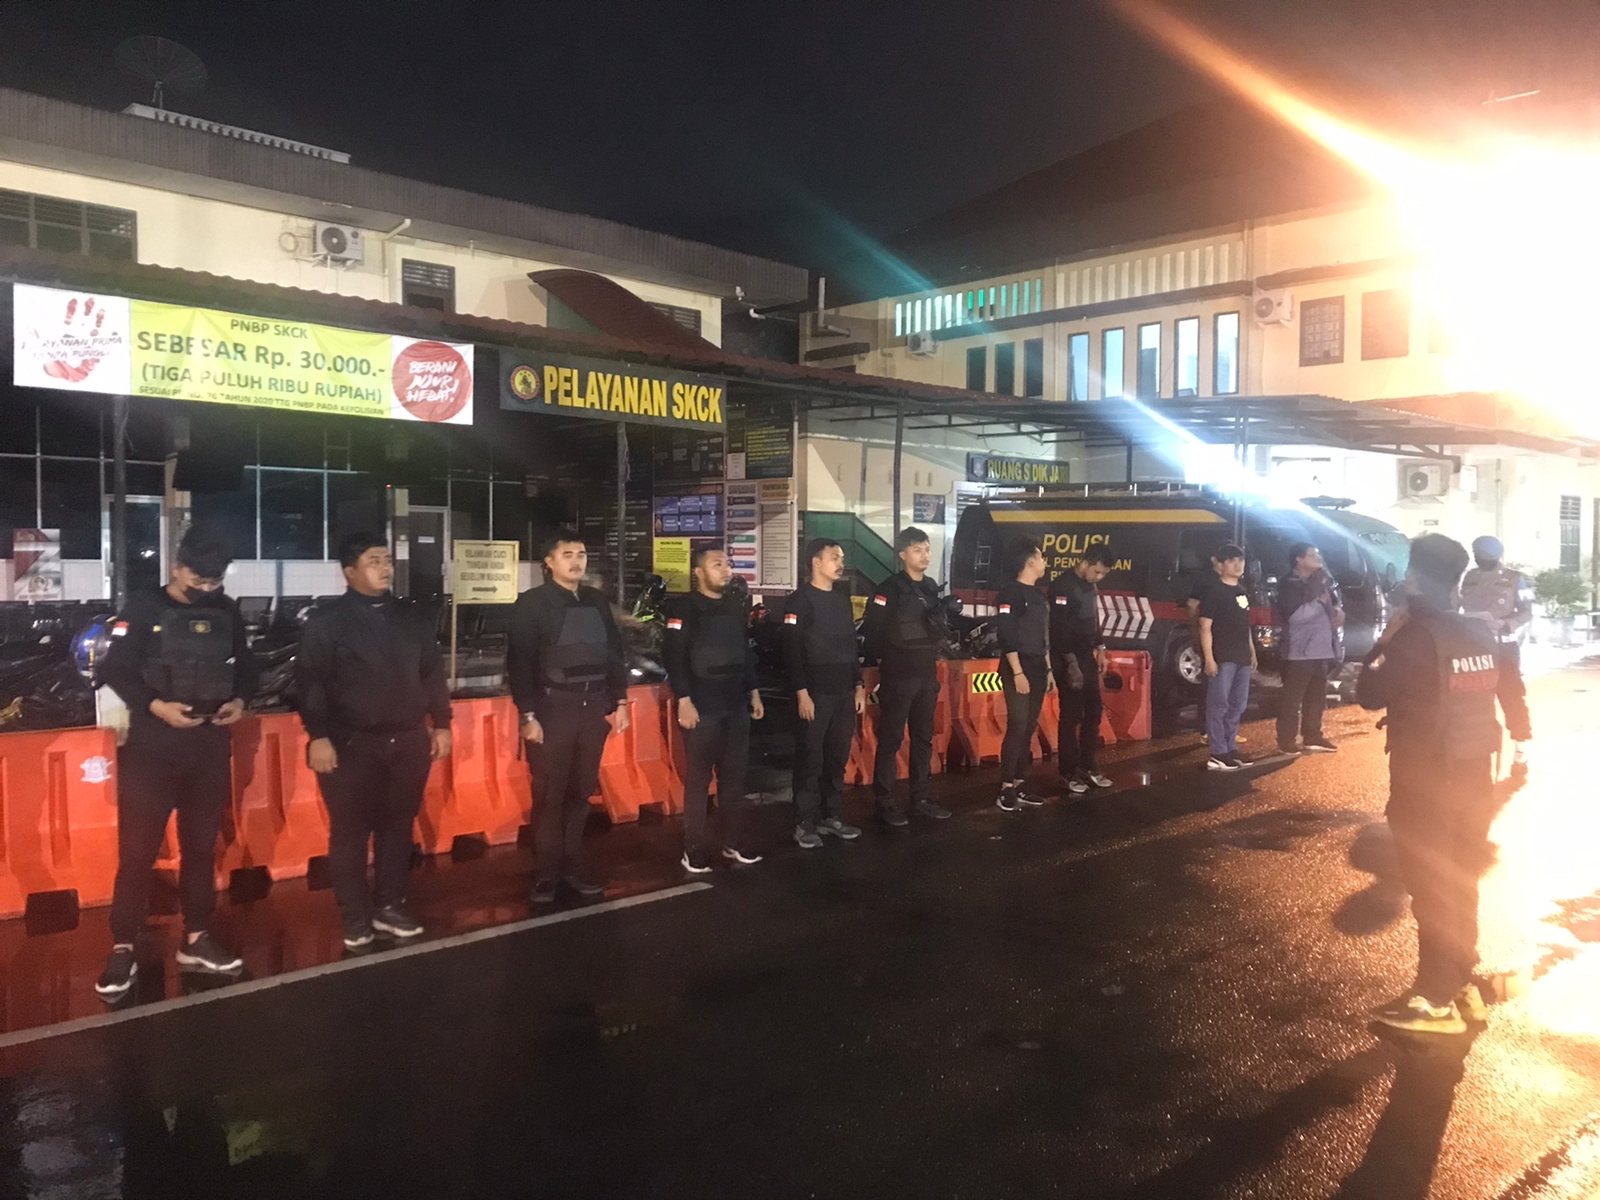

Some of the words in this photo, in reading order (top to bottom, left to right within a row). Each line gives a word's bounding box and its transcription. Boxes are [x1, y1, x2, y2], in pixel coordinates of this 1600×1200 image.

[230, 319, 270, 335] PNBP
[273, 324, 308, 340] SKCK
[137, 331, 248, 362] SEBESAR
[255, 345, 291, 370] Rp.
[300, 350, 386, 378] 30.000.-
[408, 360, 458, 374] BERANI
[142, 362, 193, 383] (TIGA
[200, 370, 263, 391] PULUH
[267, 376, 309, 395] RIBU
[314, 382, 383, 405] RUPIAH)
[543, 364, 668, 418] PELAYANAN
[671, 381, 723, 424] SKCK
[138, 385, 170, 396] SESUAI
[219, 393, 251, 404] TAHUN
[316, 402, 339, 411] PADA
[987, 459, 1021, 481] RUANG
[1022, 463, 1049, 483] SDIK
[1452, 654, 1495, 674] POLISI
